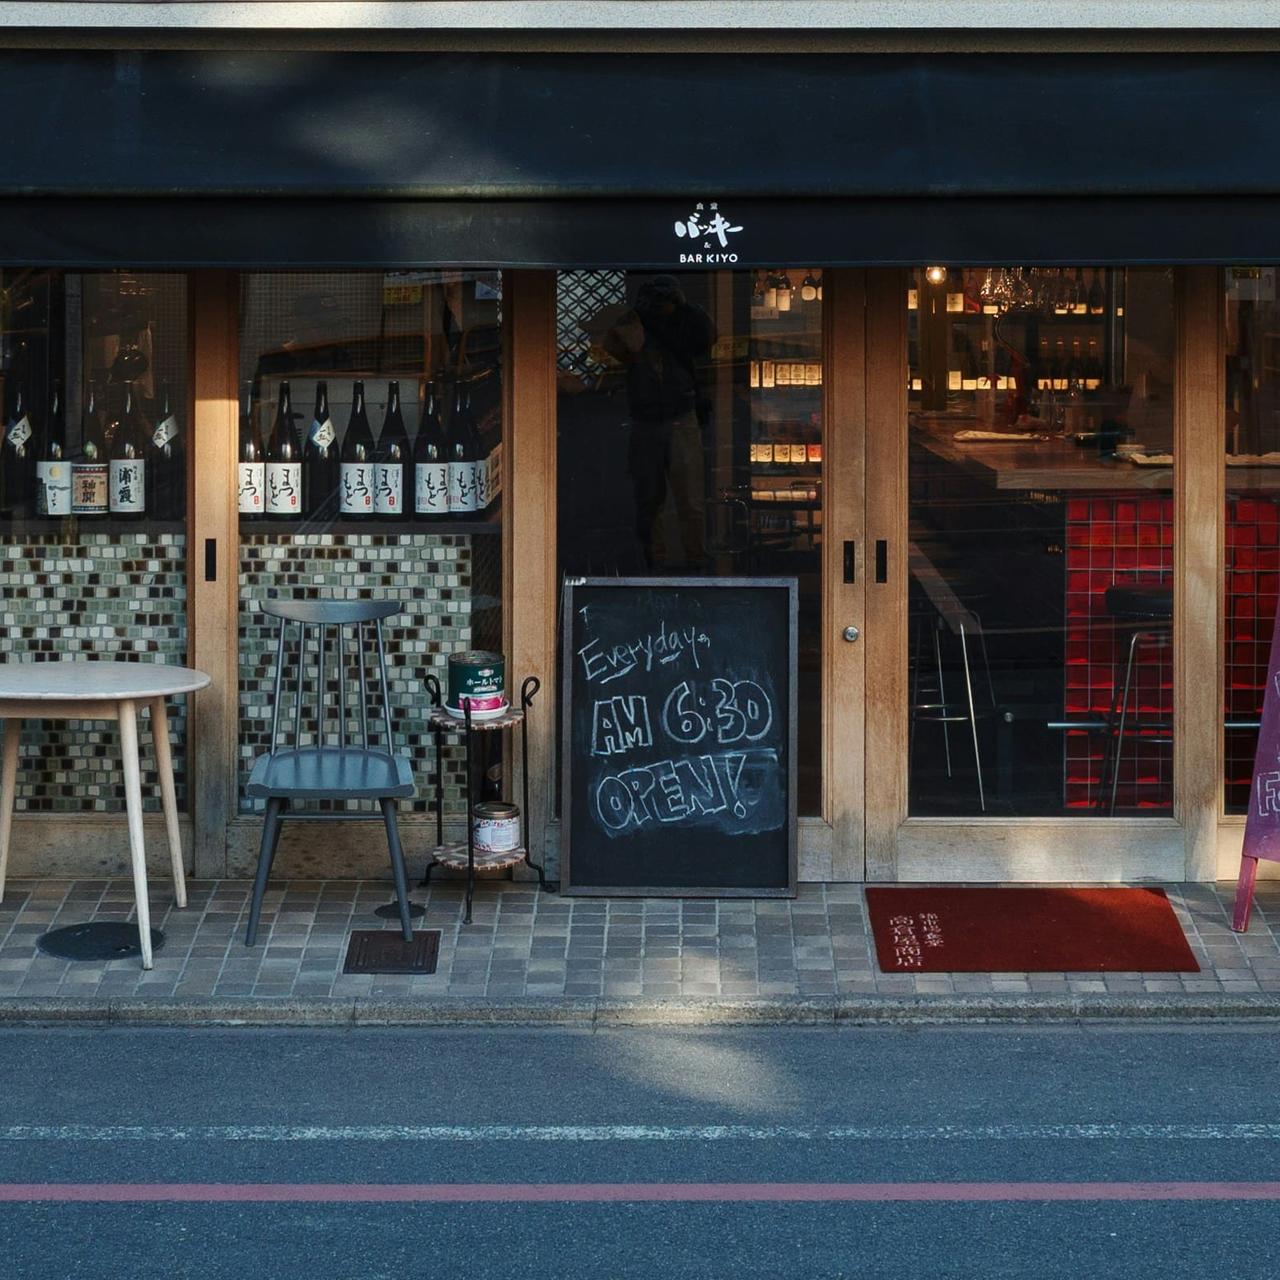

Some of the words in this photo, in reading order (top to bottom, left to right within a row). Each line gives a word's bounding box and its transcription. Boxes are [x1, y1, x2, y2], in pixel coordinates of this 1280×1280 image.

[680, 253, 703, 263] BAR
[706, 253, 738, 263] KIYO
[577, 621, 700, 680] Everyday
[592, 695, 653, 756] AM
[663, 678, 773, 743] 6:30
[596, 754, 747, 829] OPEN!
